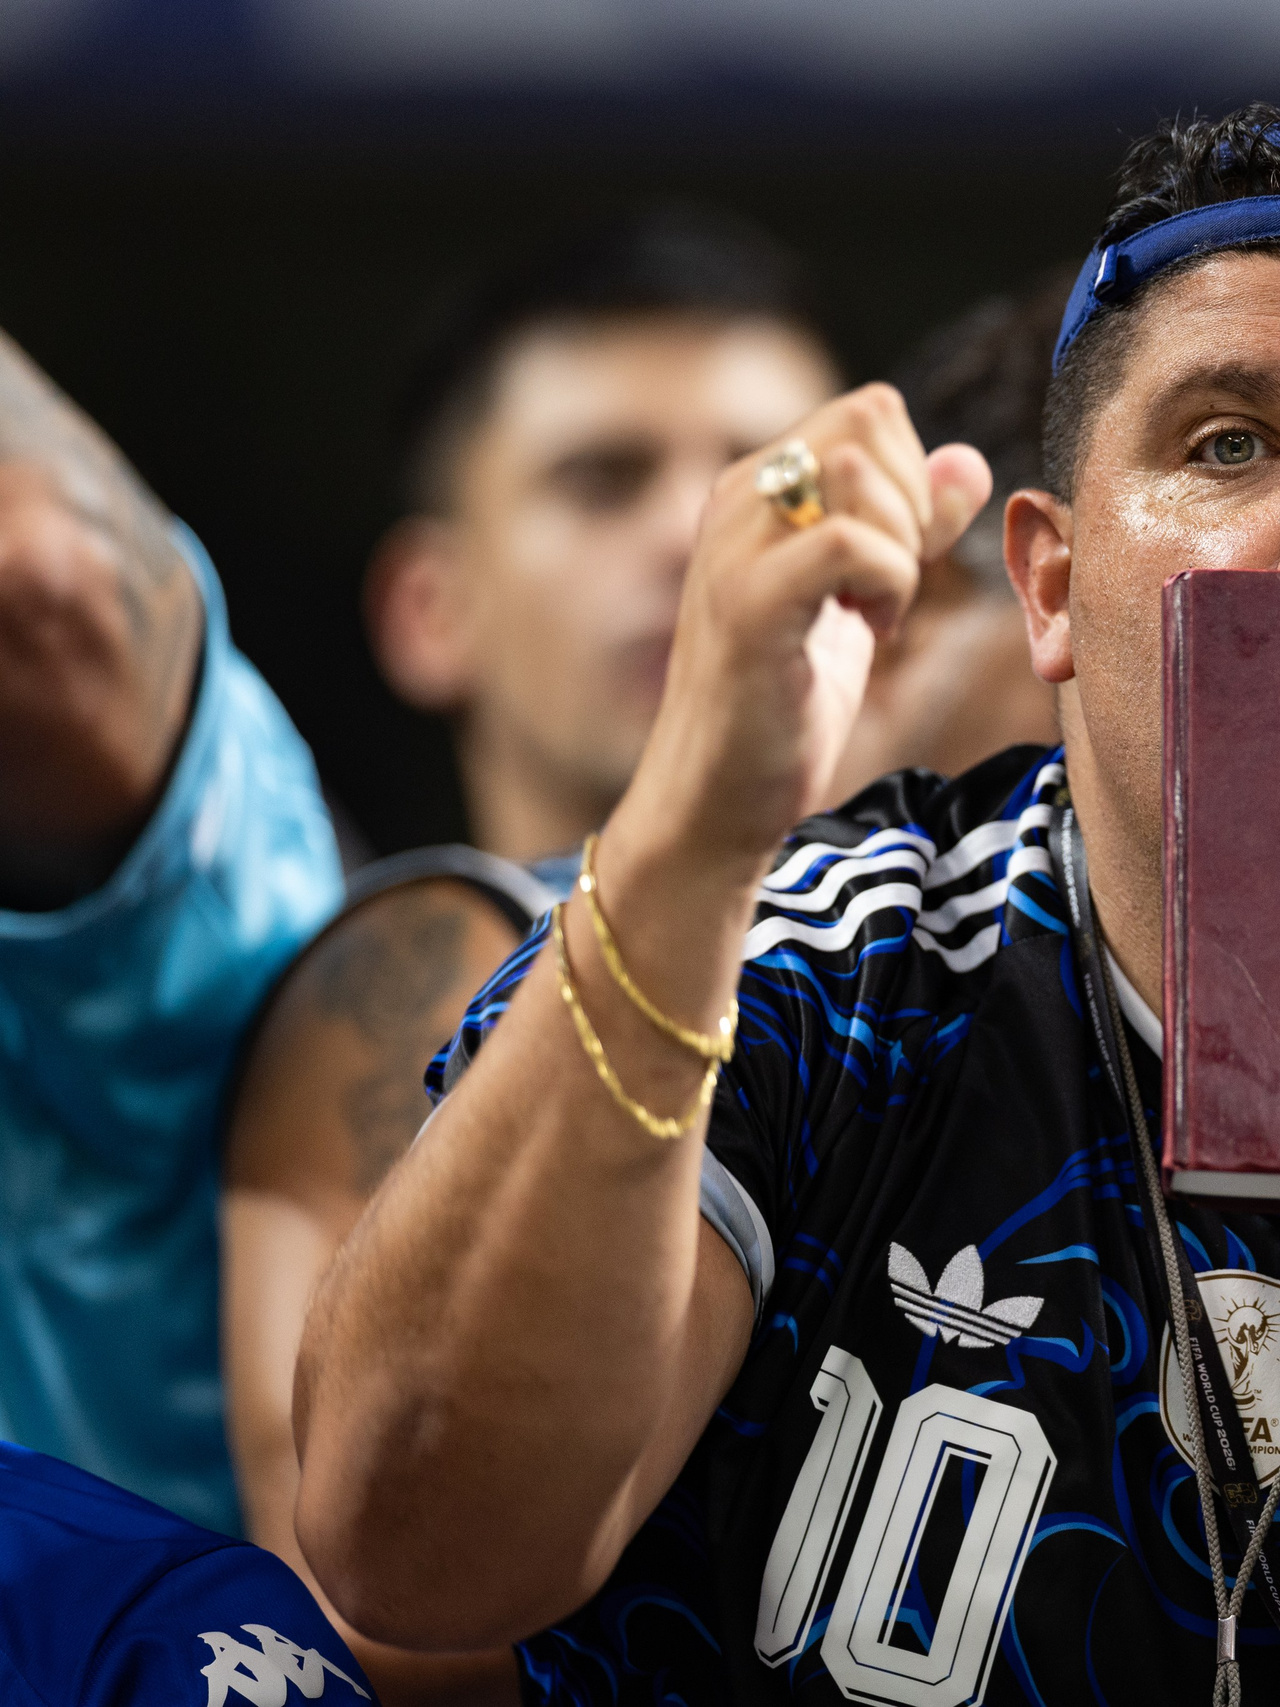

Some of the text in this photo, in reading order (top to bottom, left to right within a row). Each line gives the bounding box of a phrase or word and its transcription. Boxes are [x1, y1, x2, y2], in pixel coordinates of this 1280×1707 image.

[1189, 1336, 1204, 1361] FIFA
[1197, 1362, 1216, 1404] WORLD
[1209, 1404, 1224, 1430] CUP
[1217, 1428, 1237, 1469] 2026
[754, 1345, 1058, 1707] 10
[1259, 1552, 1274, 1585] ORLD
